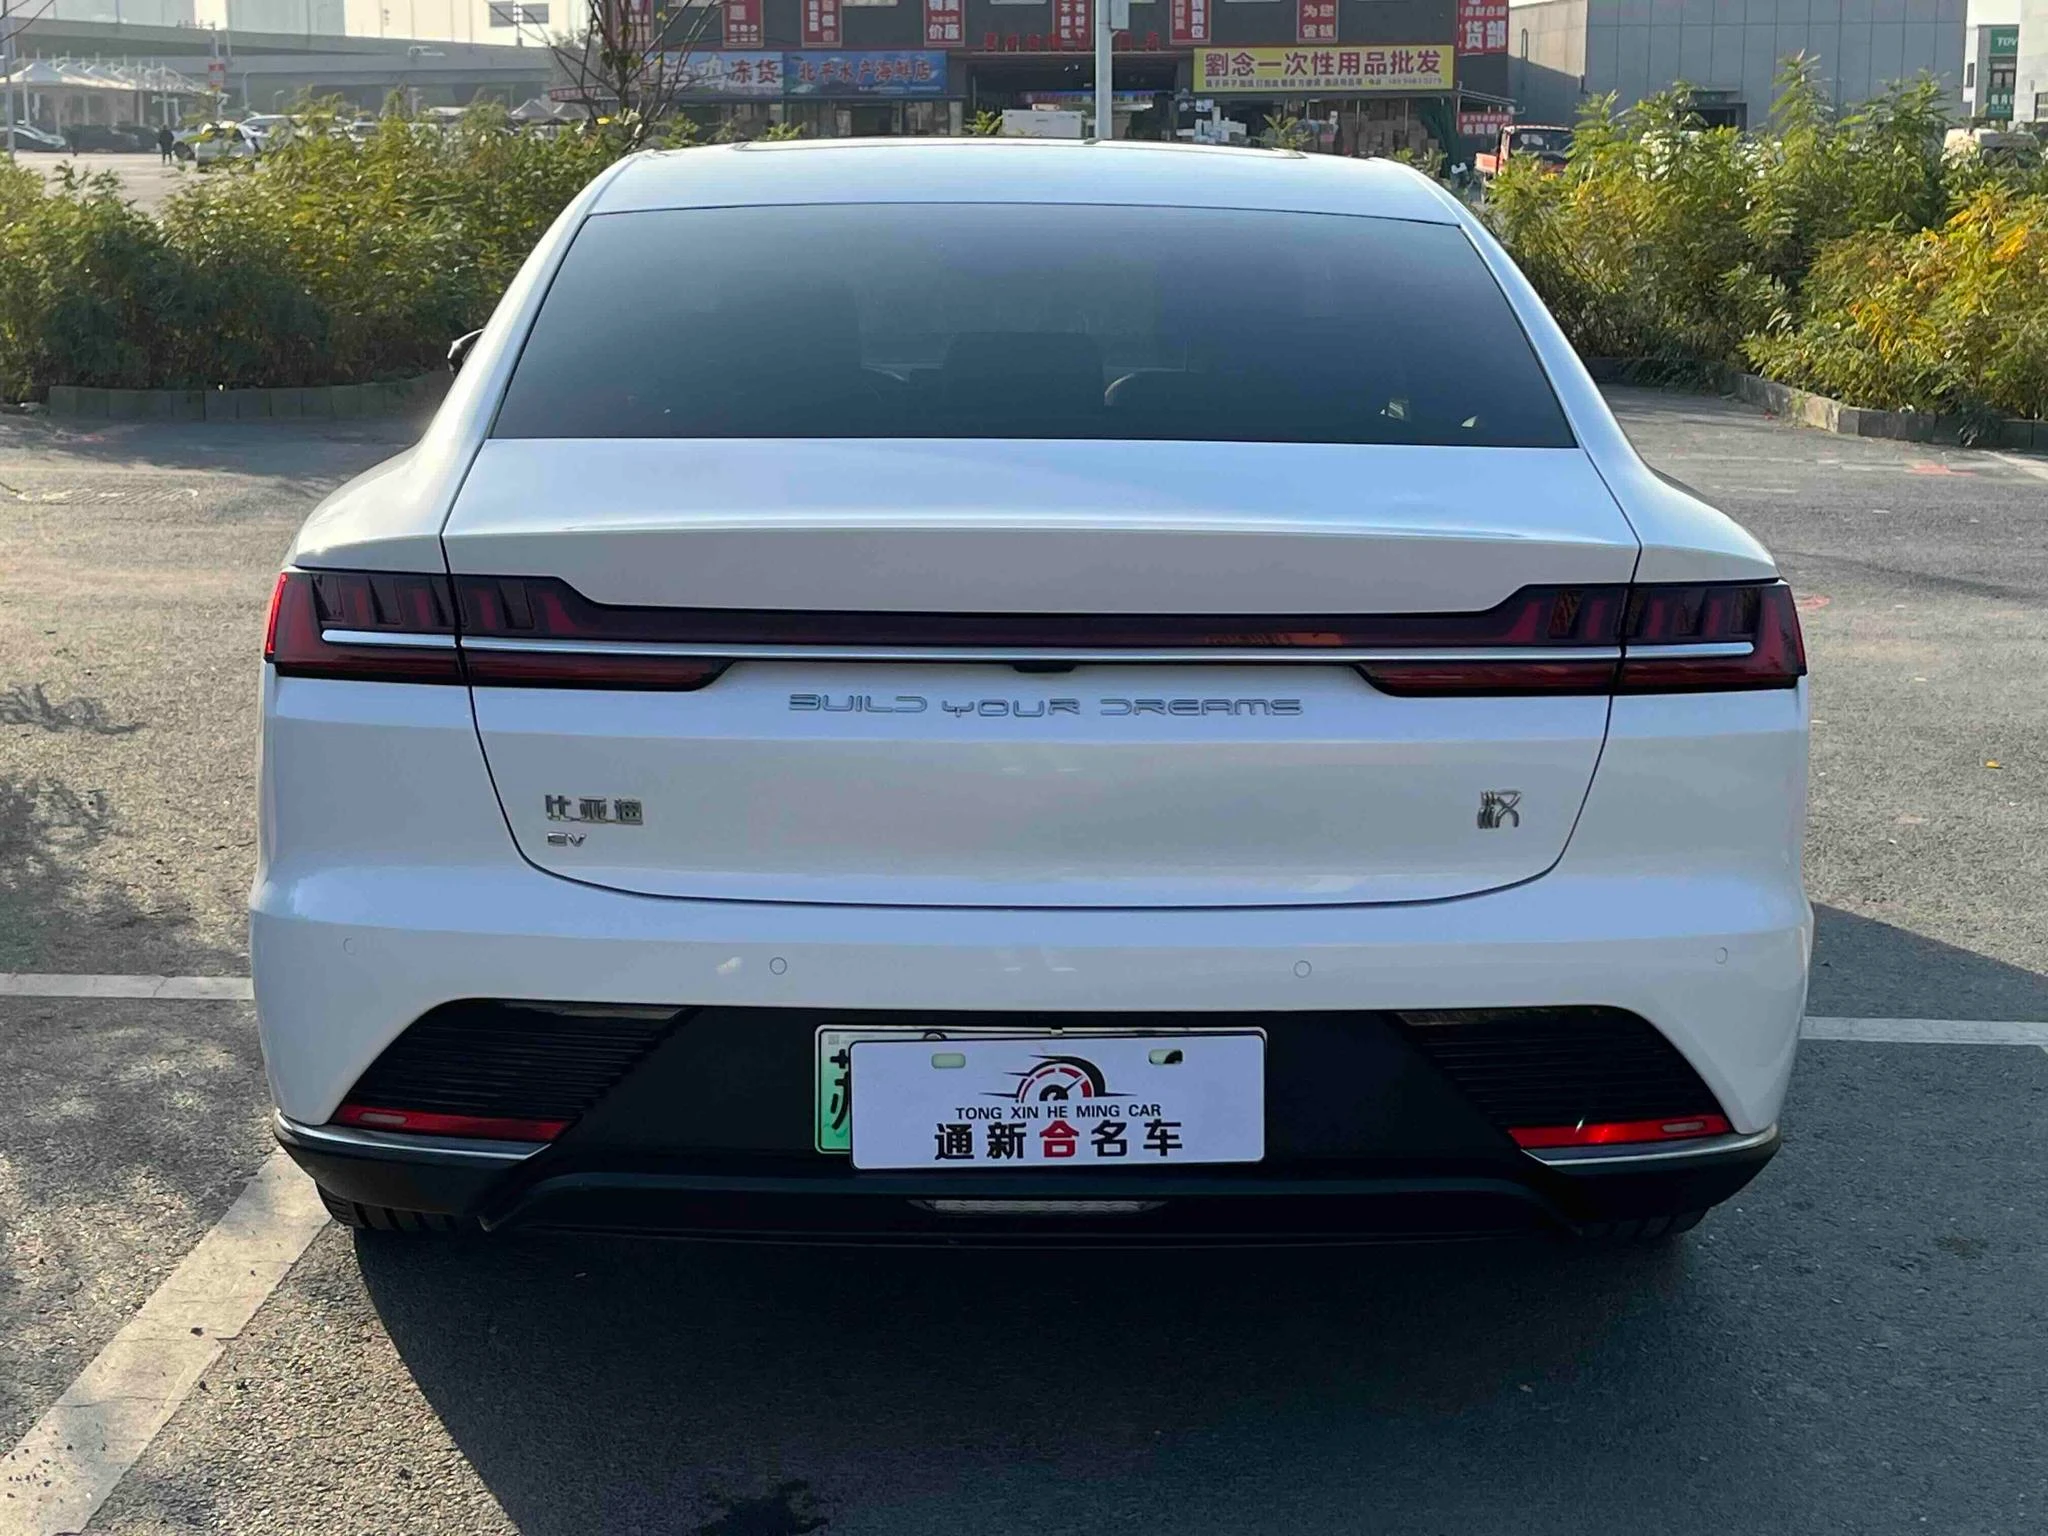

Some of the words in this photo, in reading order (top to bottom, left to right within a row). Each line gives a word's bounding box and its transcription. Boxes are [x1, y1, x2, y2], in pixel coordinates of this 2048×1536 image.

[1205, 49, 1441, 77] 劉念一次性用品批发
[789, 693, 929, 714] BUILD
[941, 698, 1081, 718] YOUR
[1100, 698, 1303, 717] DREAMS
[545, 795, 643, 825] 比亚迪
[547, 832, 587, 848] EV
[955, 1107, 1002, 1121] TONG
[1011, 1106, 1039, 1119] XIN
[1047, 1106, 1068, 1118] HE
[1076, 1104, 1120, 1119] MING
[1128, 1103, 1162, 1118] CAR
[934, 1119, 1183, 1161] 通新合名车
